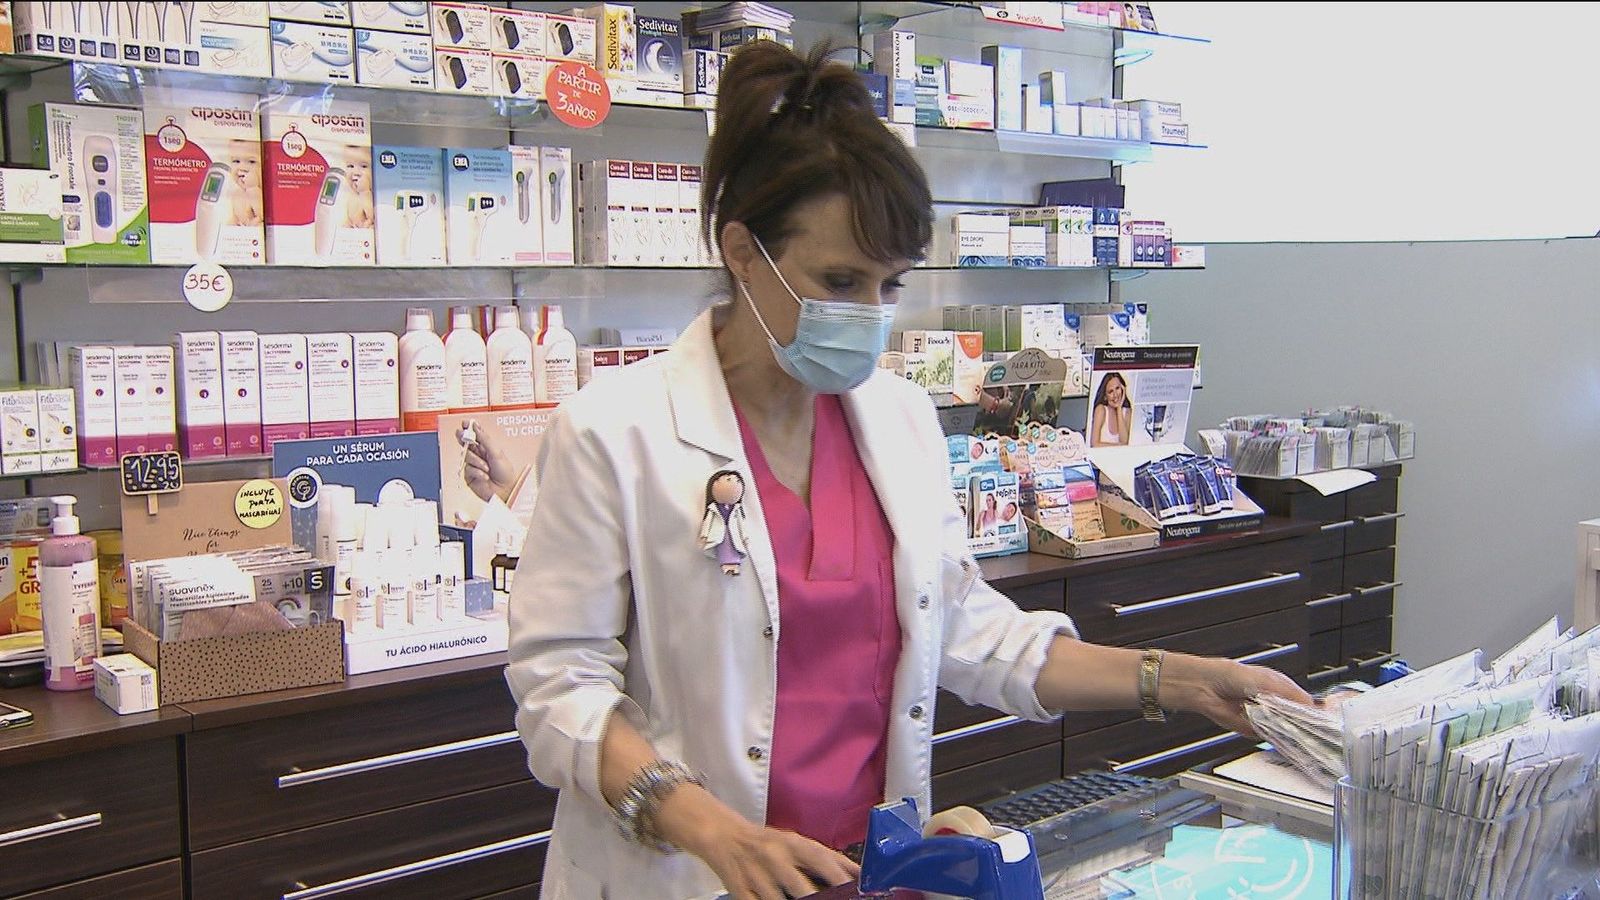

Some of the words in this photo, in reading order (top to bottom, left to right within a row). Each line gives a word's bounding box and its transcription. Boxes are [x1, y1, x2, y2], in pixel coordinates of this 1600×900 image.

[639, 18, 678, 33] Sedivitax
[607, 19, 618, 70] Sedivitax
[577, 66, 587, 78] A
[557, 70, 602, 97] PARTIR
[556, 91, 569, 110] 3
[191, 106, 252, 121] aposán
[311, 114, 365, 127] aposán
[152, 157, 208, 169] TERMÓMETRO
[277, 163, 325, 173] TERMÓMETRO
[185, 273, 225, 292] 35€
[1103, 350, 1136, 360] Neutrogena
[505, 427, 519, 436] TU
[332, 444, 348, 454] UN
[351, 441, 385, 454] SÉRUM
[306, 455, 334, 467] PARA
[336, 454, 365, 464] CADA
[366, 448, 410, 462] OCASIÓN
[1166, 525, 1201, 538] Neutrogena
[261, 579, 273, 587] 25
[282, 576, 303, 591] +10
[385, 649, 398, 658] TU
[400, 643, 427, 656] ÁCIDO
[429, 635, 488, 650] HIALURÓNICO
